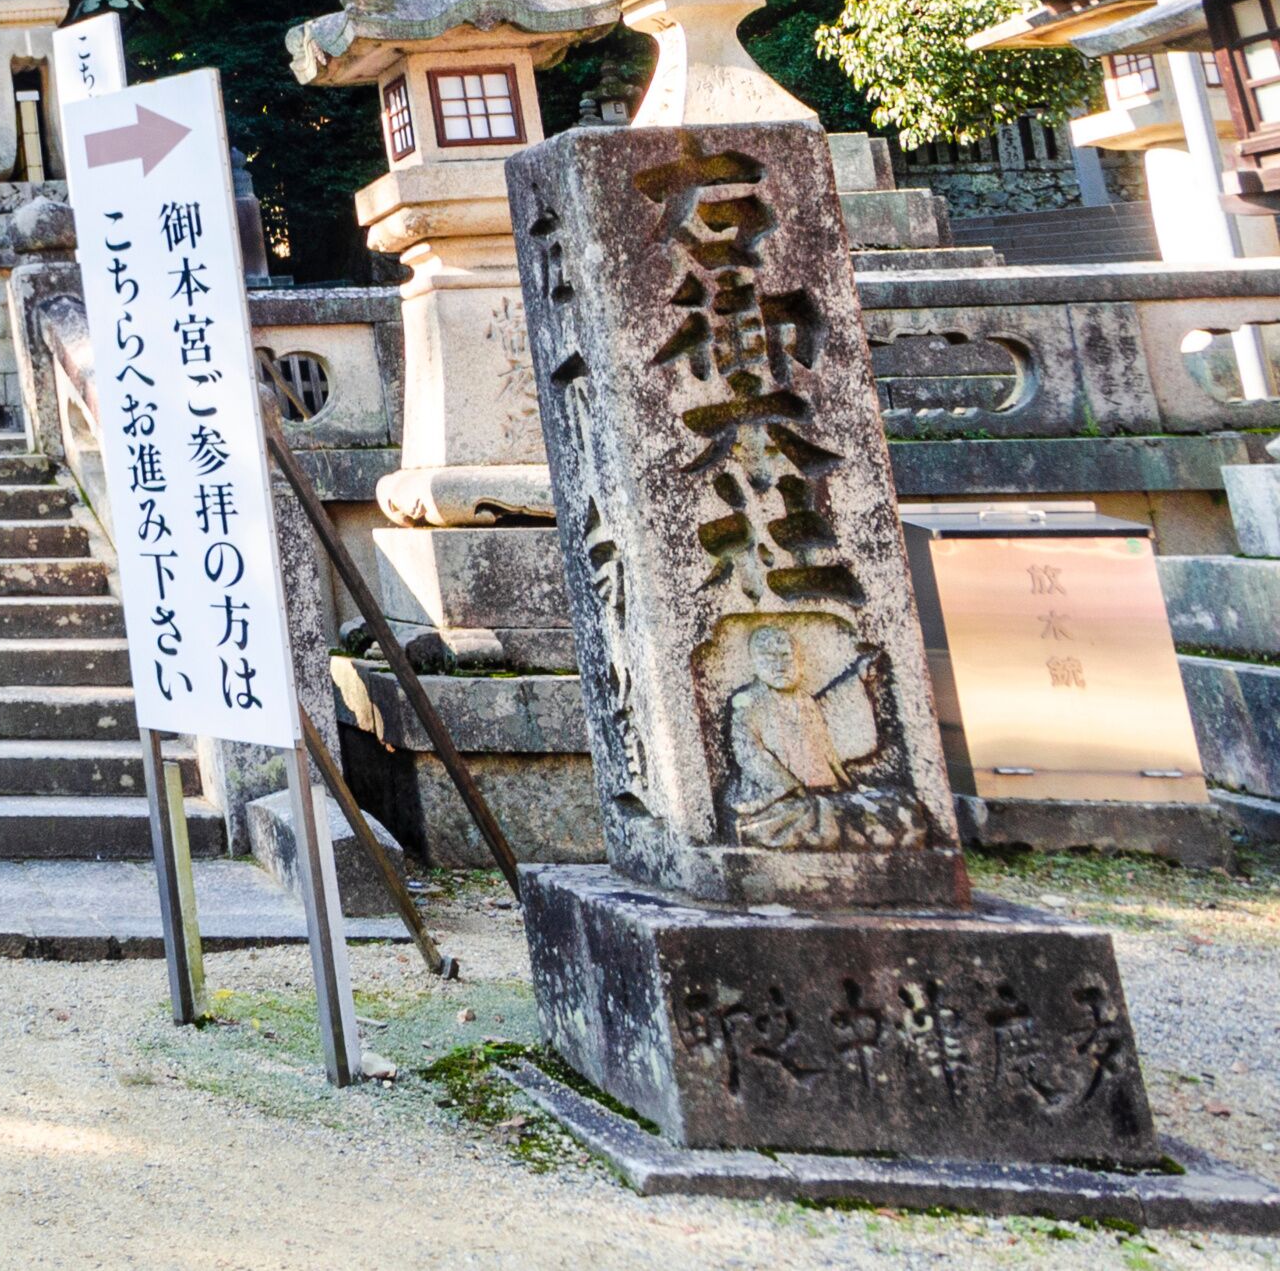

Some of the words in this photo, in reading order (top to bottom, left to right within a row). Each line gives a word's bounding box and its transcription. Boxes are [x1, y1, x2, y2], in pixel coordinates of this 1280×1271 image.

[78, 36, 96, 97] こち
[103, 210, 192, 702] こちらへお進み下さい
[159, 200, 263, 711] 御本宮ご参拝の方は
